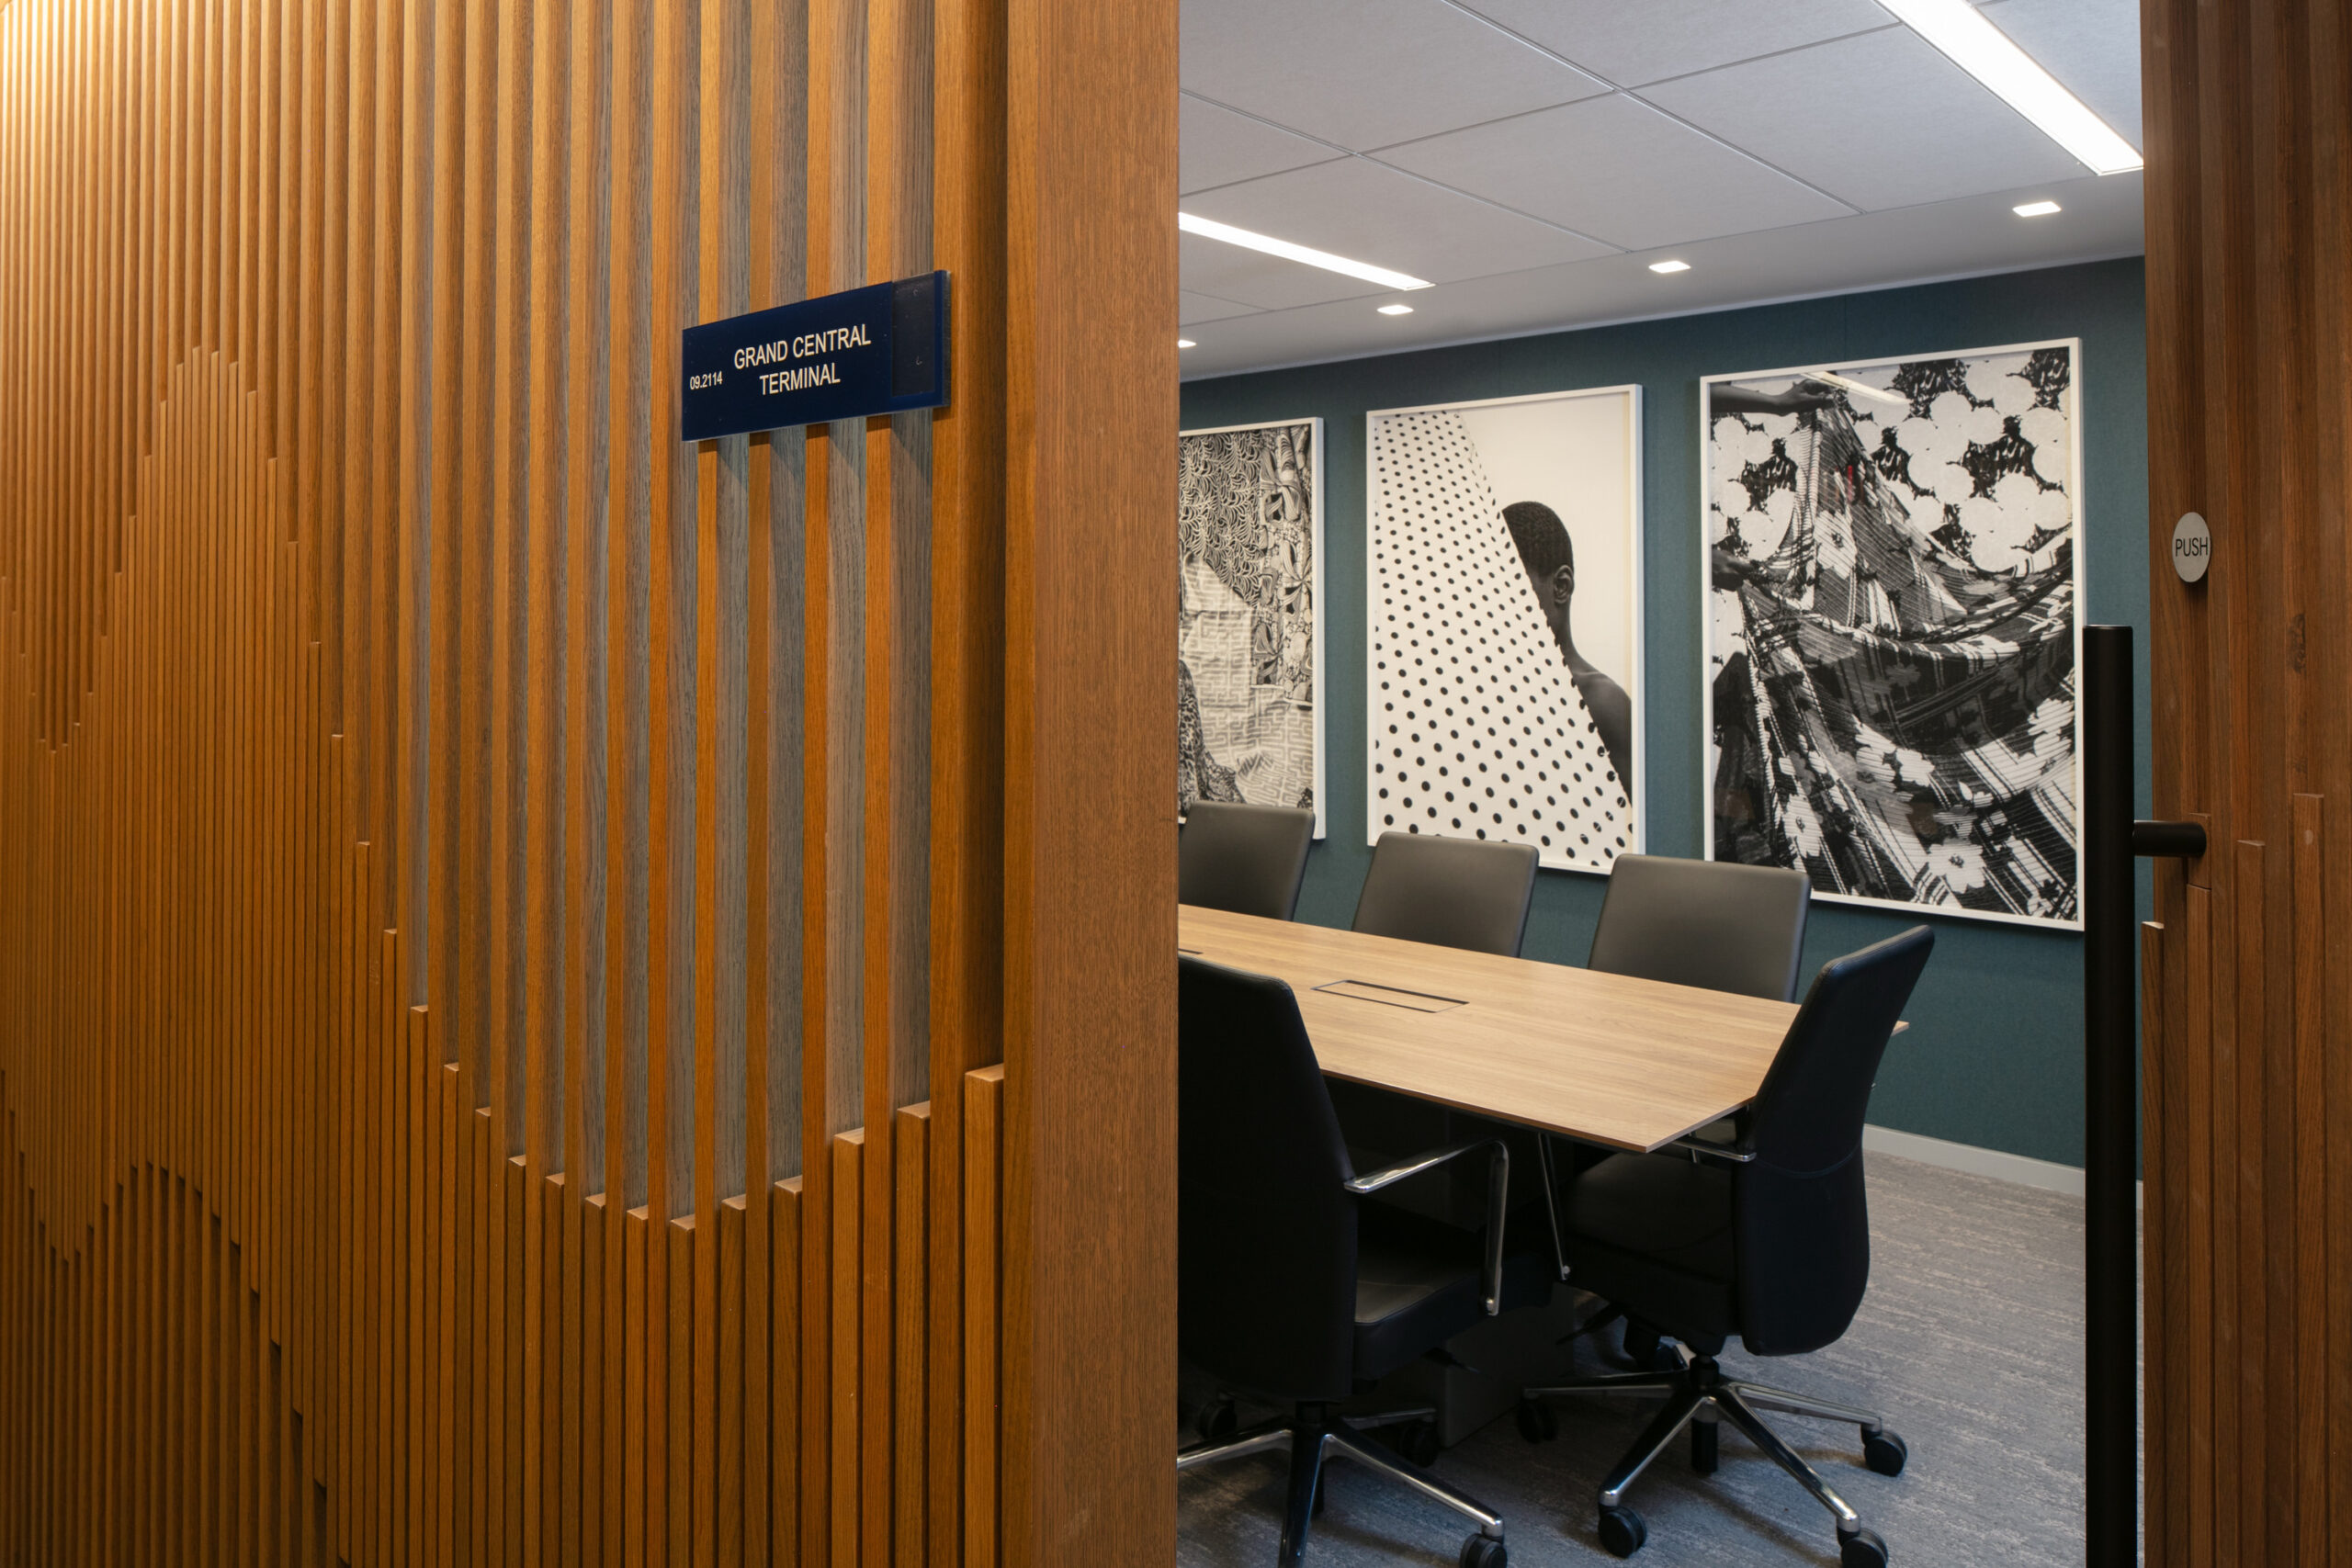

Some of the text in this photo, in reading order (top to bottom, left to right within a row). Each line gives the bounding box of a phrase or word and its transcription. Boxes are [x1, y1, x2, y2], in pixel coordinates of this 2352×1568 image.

[734, 323, 872, 370] GRAND CENTRAL
[689, 370, 723, 390] 09.2114
[759, 362, 841, 396] TERMINAL
[2175, 536, 2209, 558] PUSH
